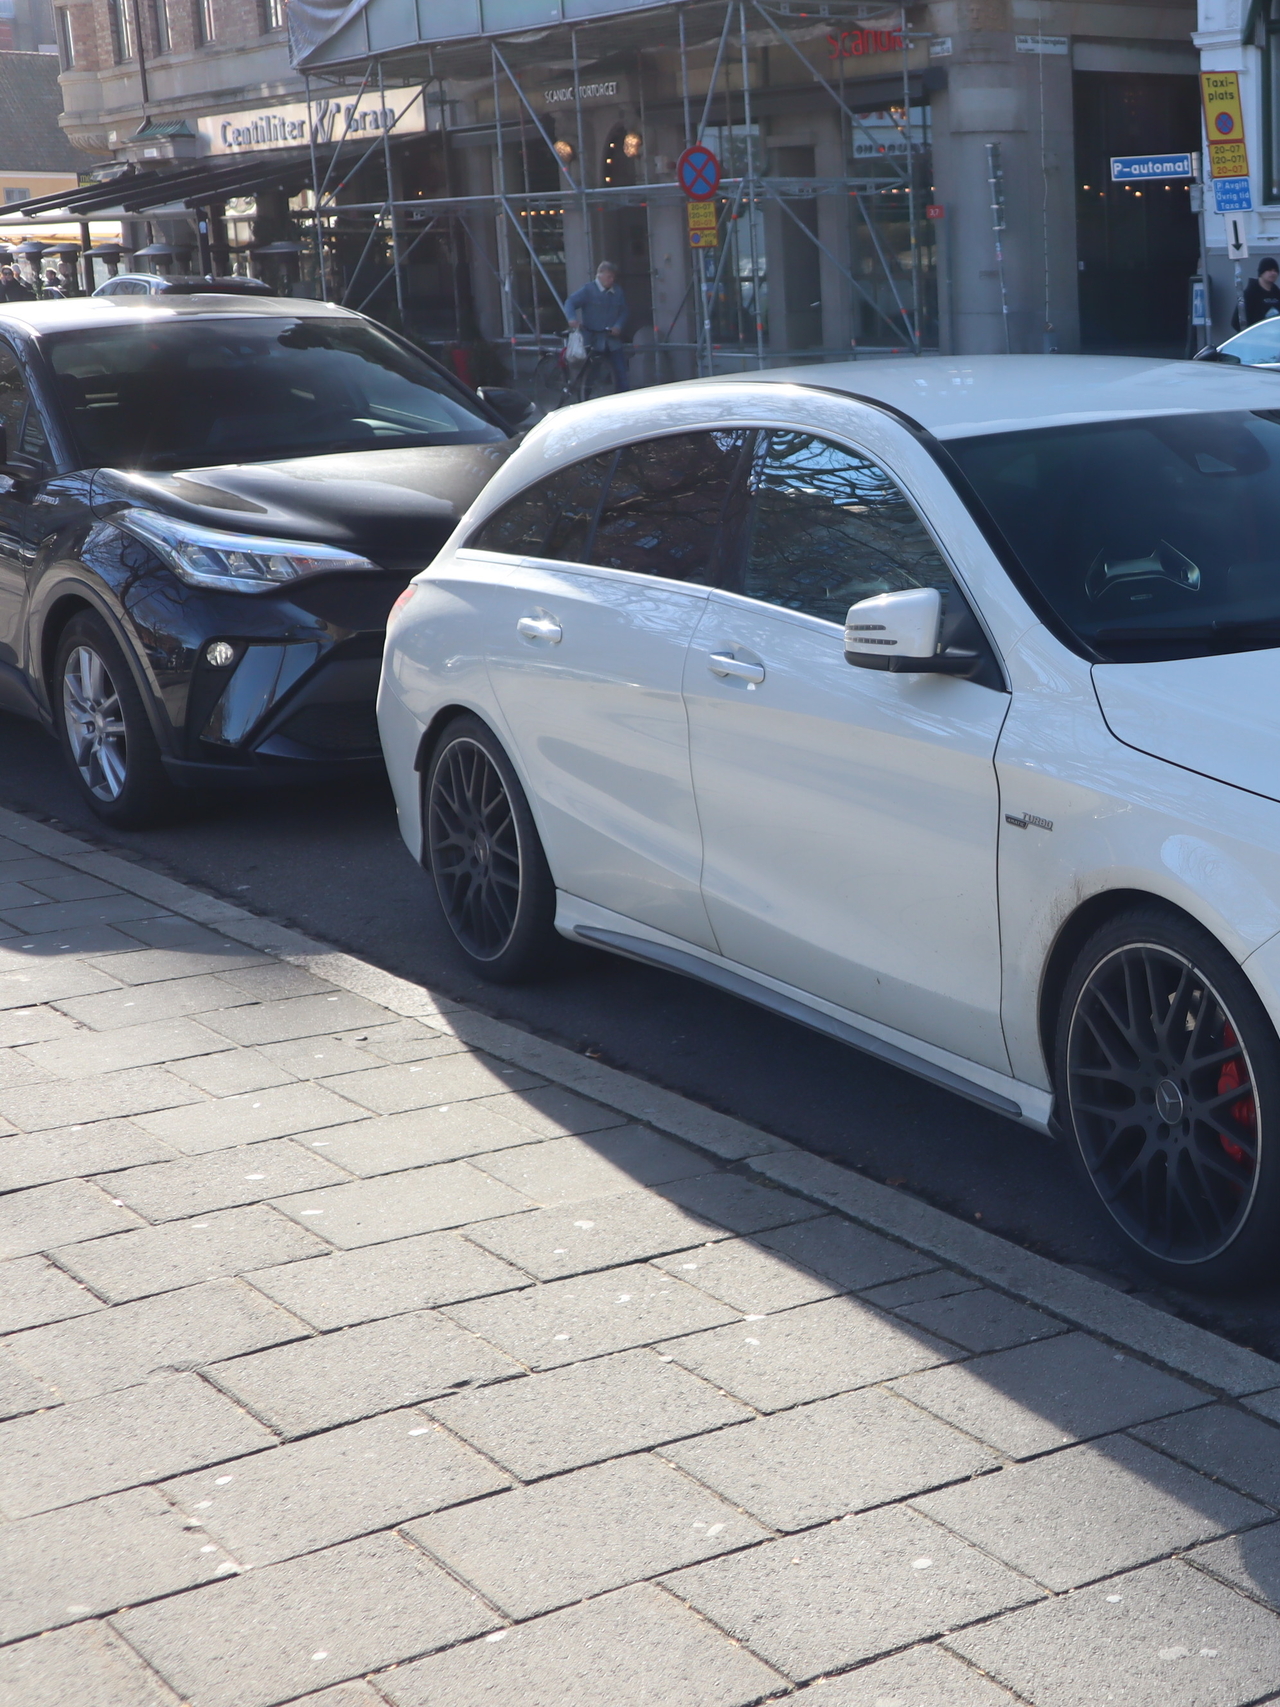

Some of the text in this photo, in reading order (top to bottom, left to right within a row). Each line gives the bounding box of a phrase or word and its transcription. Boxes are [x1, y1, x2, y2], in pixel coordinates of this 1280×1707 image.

[1205, 76, 1235, 88] Taxi-
[544, 82, 617, 104] SCANDIC TORTORGET
[1207, 90, 1235, 103] plats
[220, 115, 306, 148] Centiliter
[344, 104, 396, 133] Gram
[1213, 145, 1240, 154] 20-07
[1212, 154, 1245, 165] (20-07)
[1113, 159, 1189, 175] P-automat
[1216, 165, 1243, 174] 20-07
[1224, 181, 1248, 190] Avgift
[1216, 191, 1250, 201] Övrig tid
[691, 203, 711, 211] 20-07
[1220, 200, 1248, 210] Taxa A
[1022, 811, 1054, 831] TURBO
